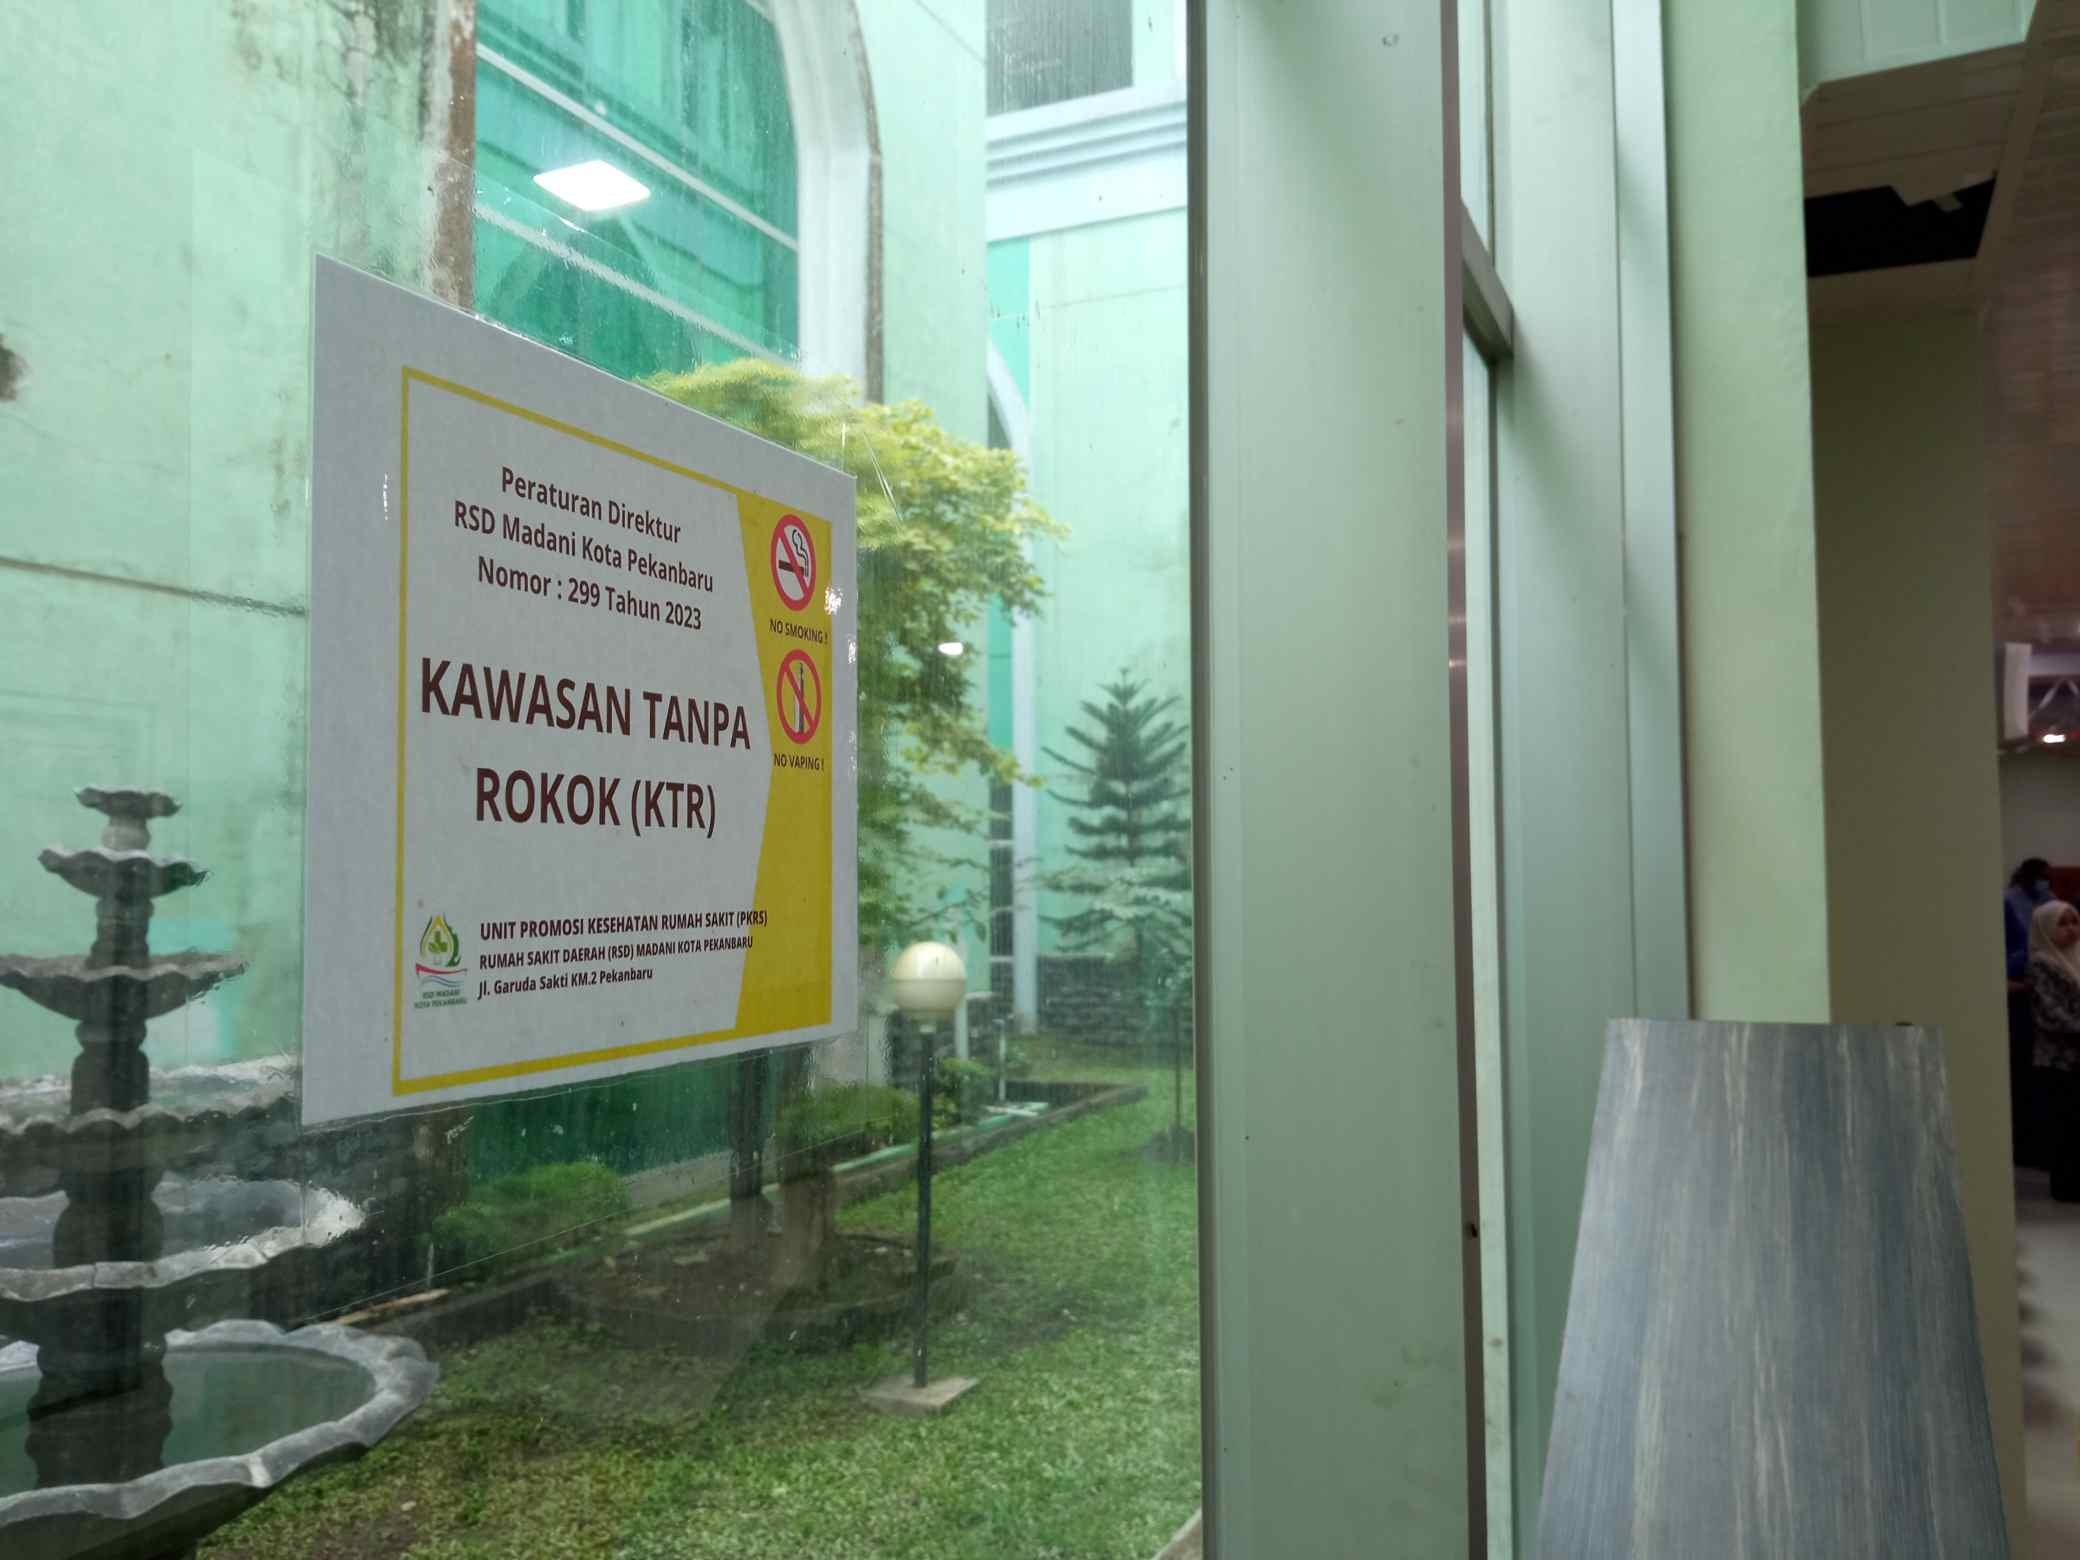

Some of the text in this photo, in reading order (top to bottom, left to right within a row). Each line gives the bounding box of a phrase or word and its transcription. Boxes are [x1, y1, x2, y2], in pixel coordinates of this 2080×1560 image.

[501, 466, 681, 544] Peraturan Direktur
[454, 500, 713, 593] RSD Madani Kota Pekanbaru
[478, 556, 702, 630] Nomor : 299 Tahun 2023
[769, 619, 783, 634] NO
[785, 622, 823, 643] SMOKING
[421, 657, 751, 750] KAWASAN TANPA
[774, 753, 787, 767] NO
[788, 754, 821, 770] VAPING
[476, 767, 716, 838] ROKOK (KTR)
[480, 909, 768, 940] UNIT PROMOSI KESEHATAN RUMAH SAKIT (PKRS)
[480, 935, 753, 970] RUMAH SAKIT DAERAH (RSD) MADANI KOTA PEKANBARU
[477, 967, 653, 1001] Jl. Garuda Sakti KM.2 Pekanbaru
